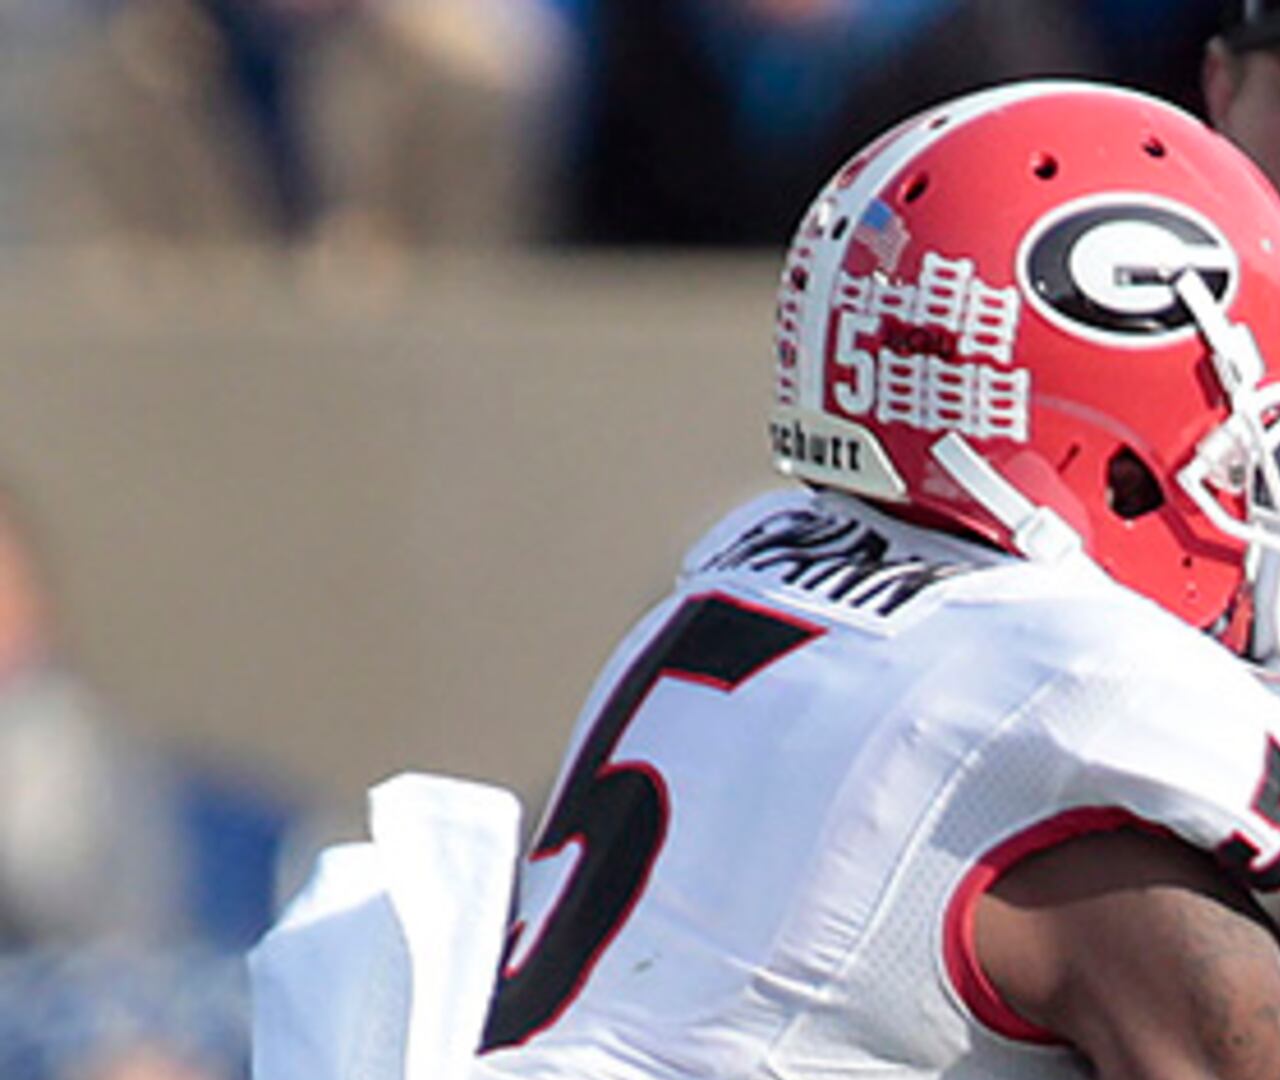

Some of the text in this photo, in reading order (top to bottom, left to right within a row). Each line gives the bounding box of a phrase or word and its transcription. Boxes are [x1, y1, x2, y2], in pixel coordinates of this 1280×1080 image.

[1017, 192, 1239, 349] G
[834, 310, 876, 414] 5
[476, 589, 829, 1056] 5
